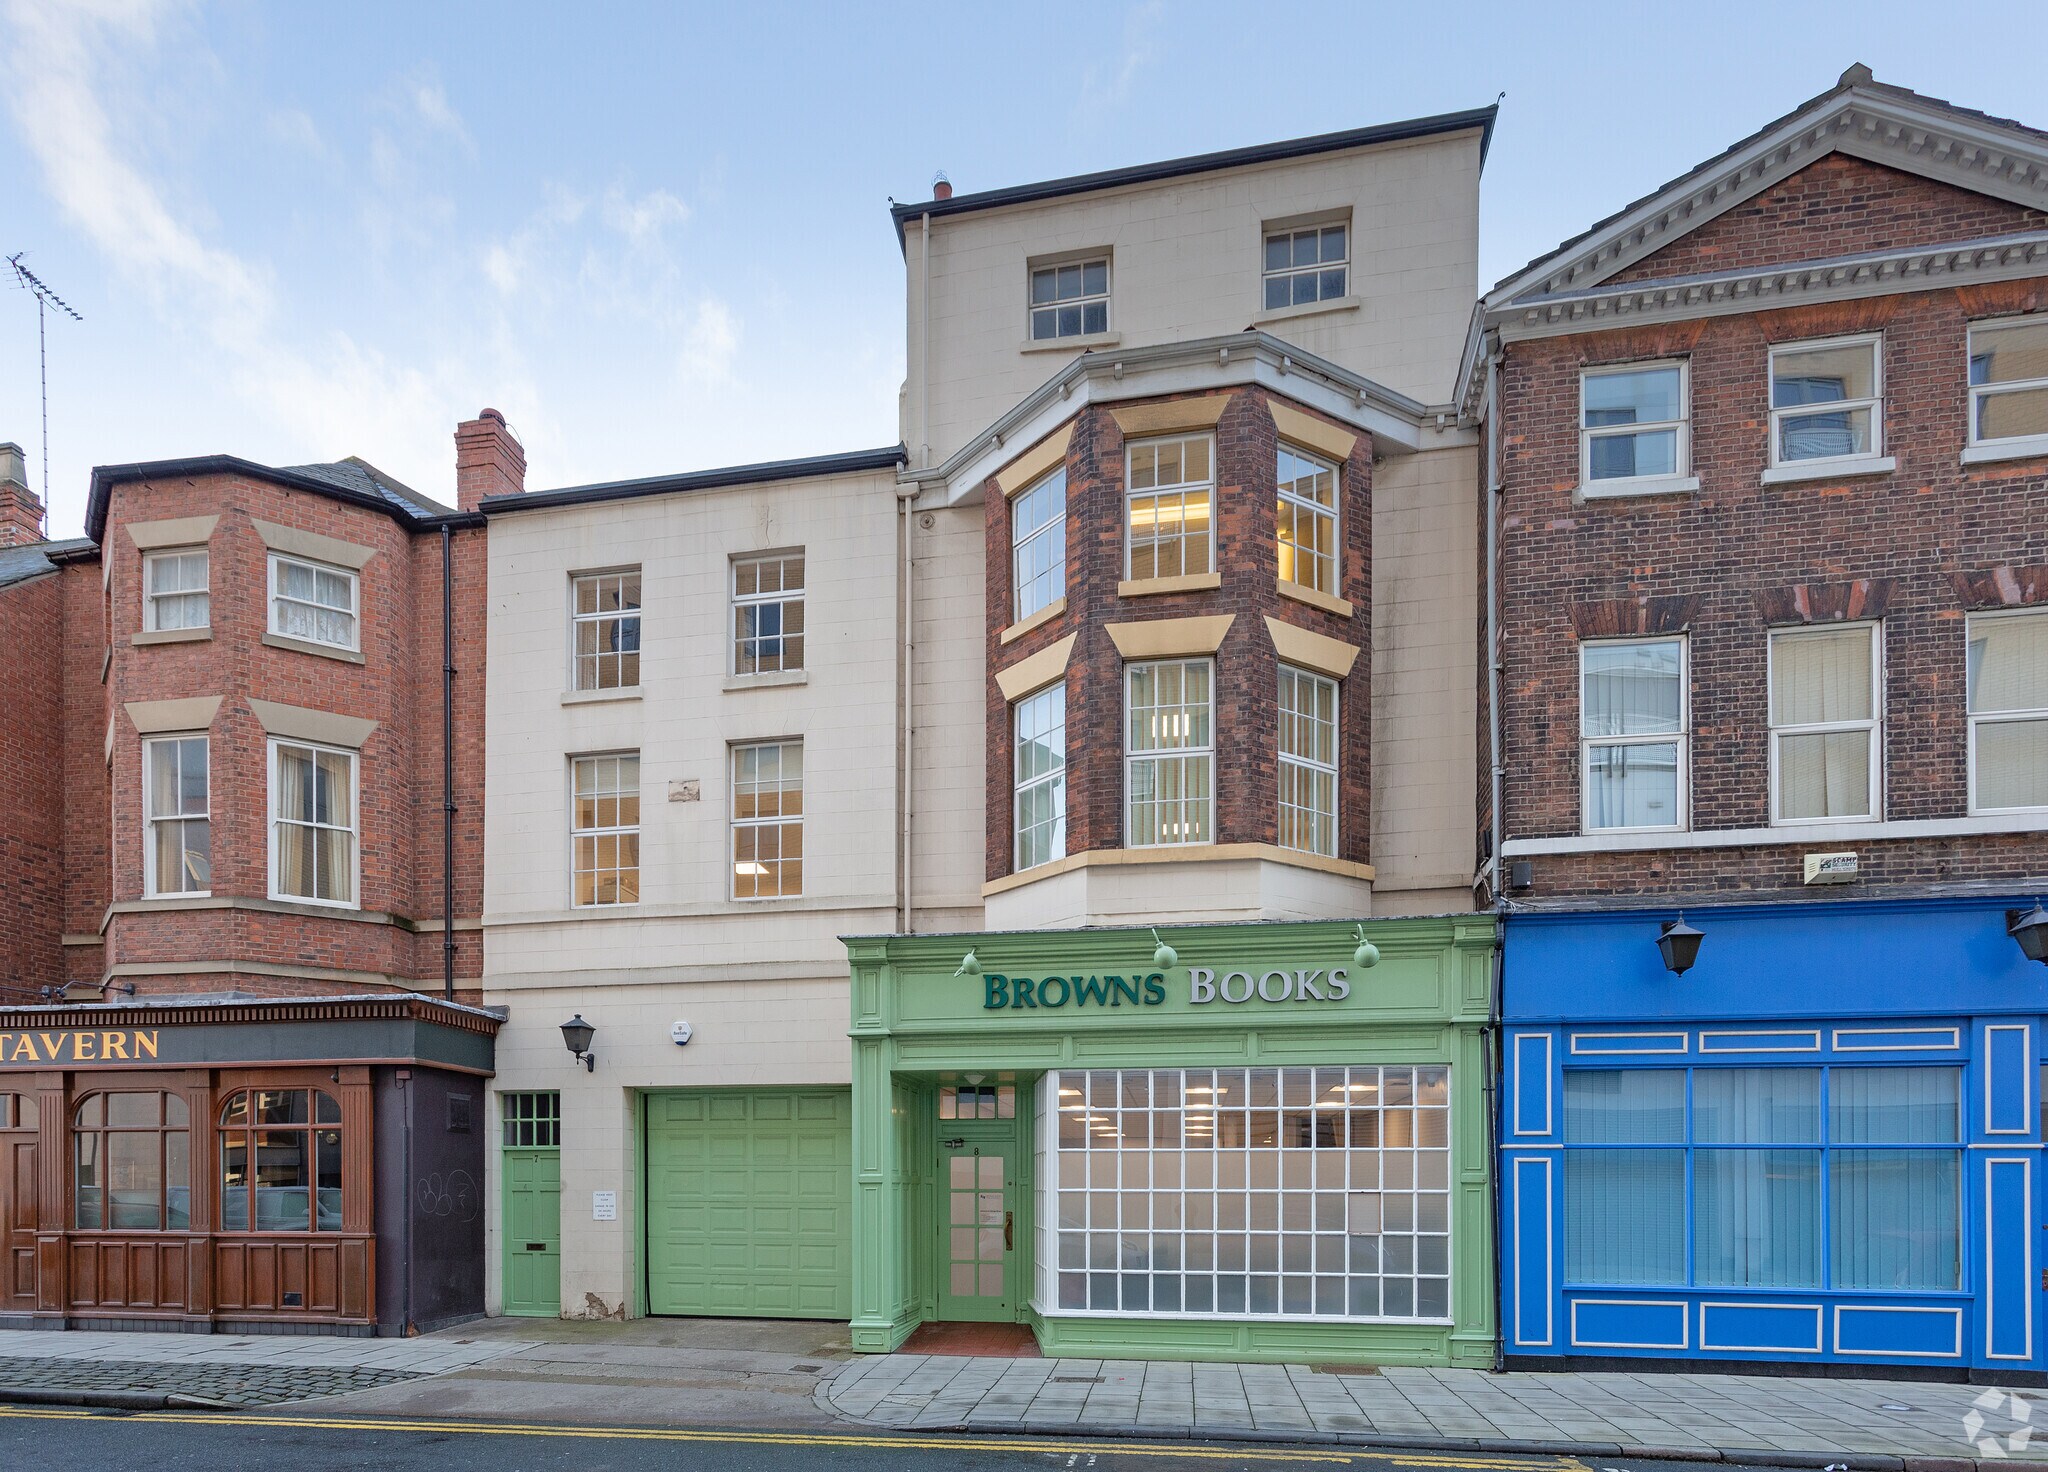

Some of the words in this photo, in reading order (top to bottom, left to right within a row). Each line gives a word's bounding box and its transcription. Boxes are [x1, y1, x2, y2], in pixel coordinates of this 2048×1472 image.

[983, 973, 1166, 1010] BROWNS
[1188, 967, 1352, 1005] BOOKS
[0, 1030, 160, 1062] TAVERN
[534, 1154, 539, 1163] 7
[974, 1147, 979, 1156] 8
